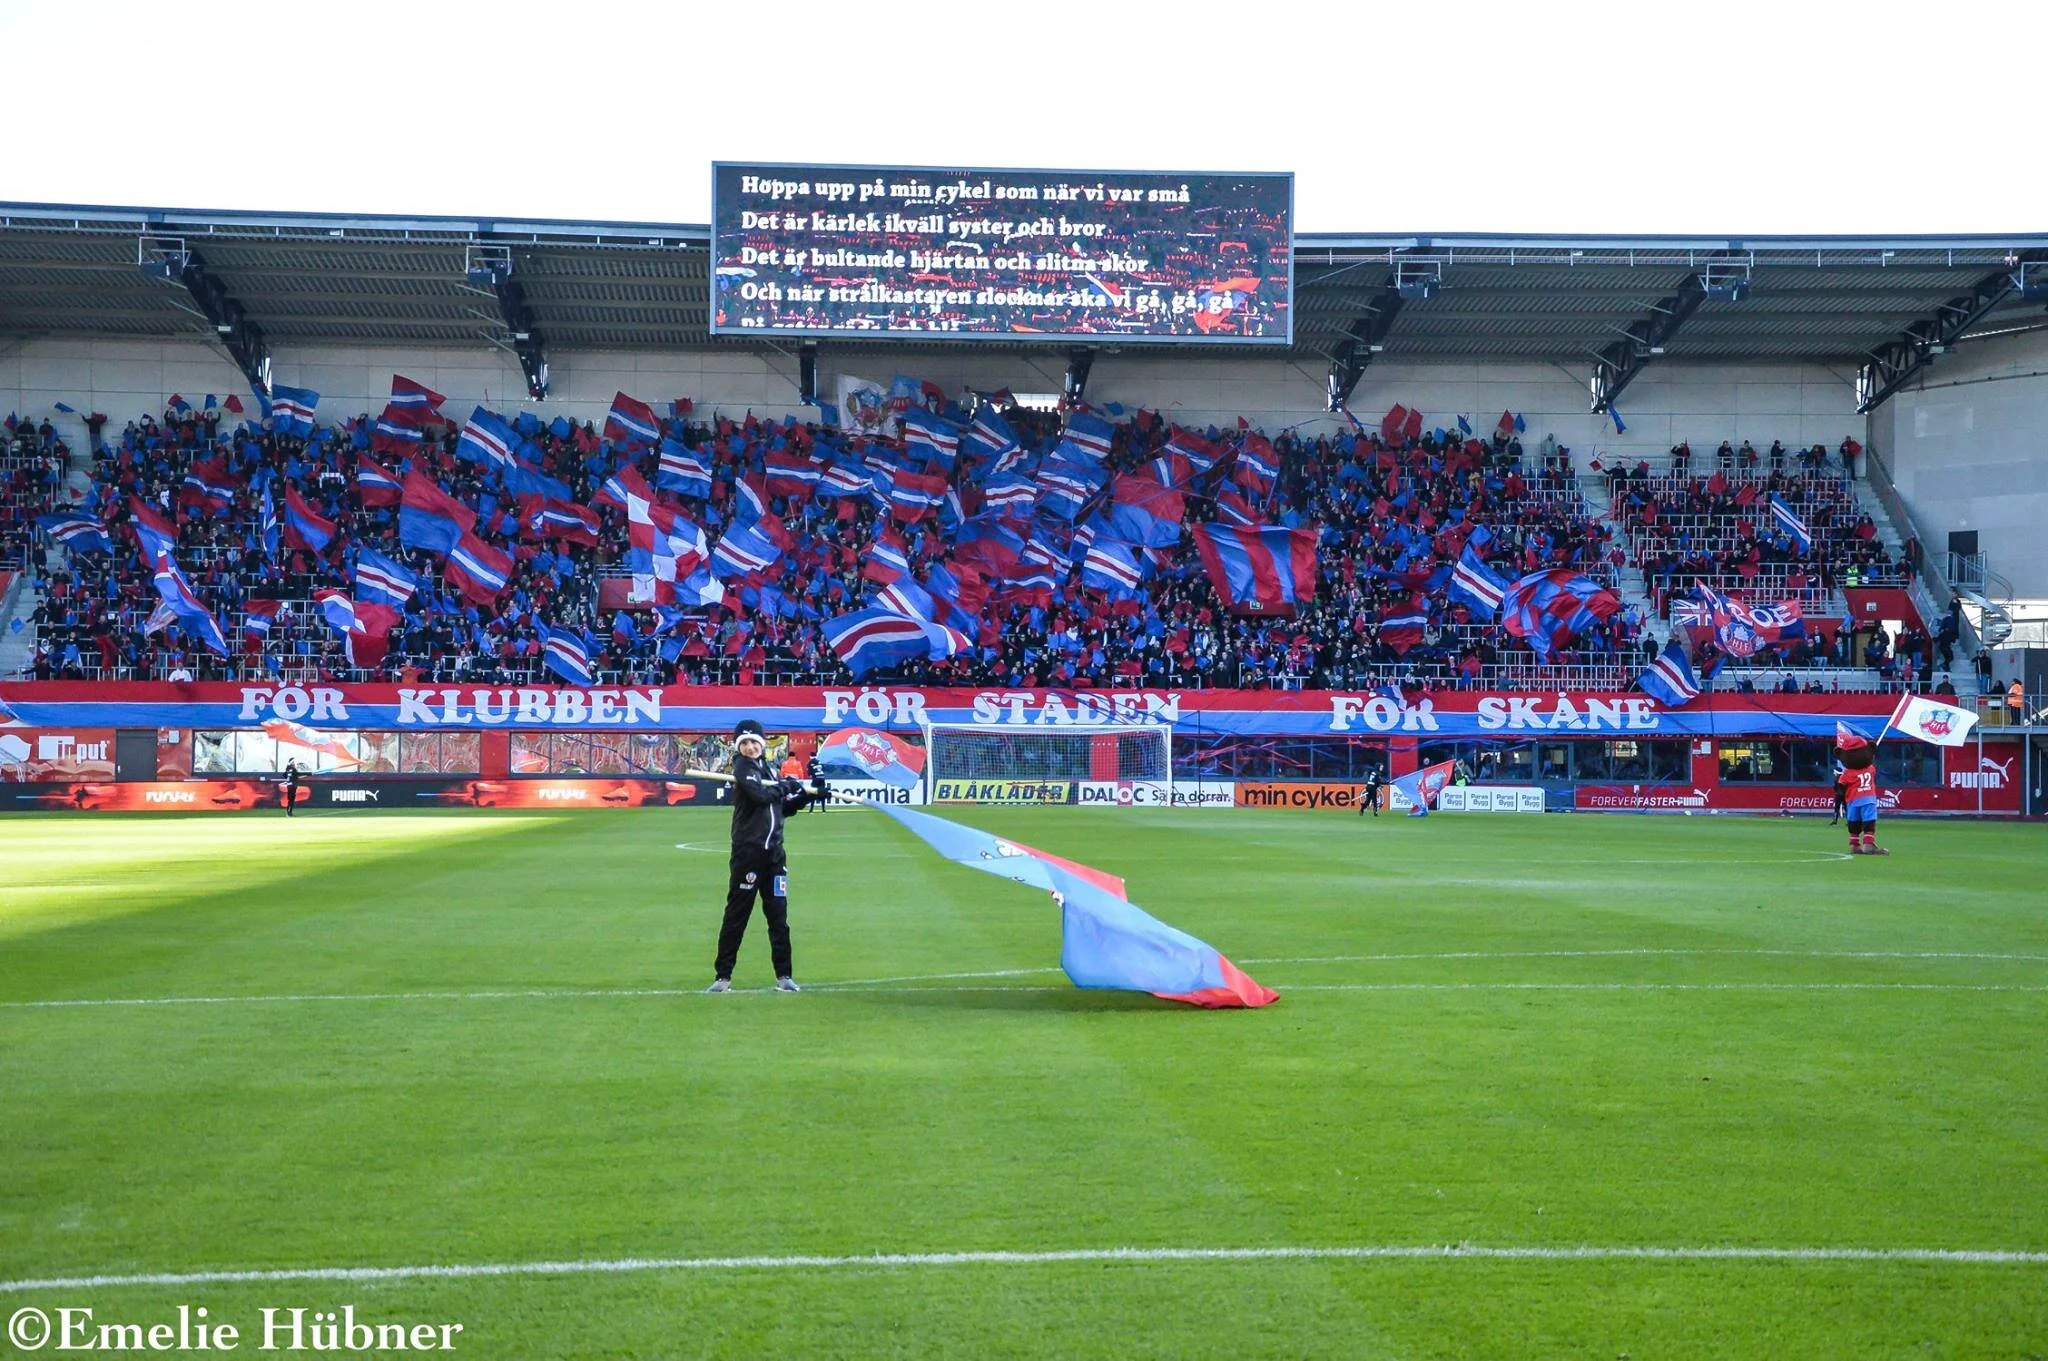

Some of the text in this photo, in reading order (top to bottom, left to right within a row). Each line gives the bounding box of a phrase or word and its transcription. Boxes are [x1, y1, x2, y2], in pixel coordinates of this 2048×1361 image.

[741, 176, 1189, 204] Hoppa upp på min cykel som när vi var små
[741, 211, 1107, 239] Det är kärlek ikväll syster och bror
[741, 247, 1149, 274] Det är bultande hjärtan och slitna skor
[741, 282, 782, 301] Och
[787, 284, 825, 302] när
[829, 283, 971, 305] strålkastaren
[977, 288, 1066, 306] slocknar
[1070, 290, 1106, 307] ska
[1112, 291, 1130, 307] vi
[1209, 290, 1233, 314] gå
[238, 683, 1659, 731] FÖR KLUBBEN FÖR STADEN FÖR SKÅNE
[1857, 772, 1871, 787] 12
[1951, 772, 2000, 788] PUMA
[332, 790, 366, 801] PUMA
[814, 783, 910, 804] hermia
[938, 781, 1063, 800] BLÅKLÄDER
[1083, 787, 1144, 802] DALOC
[1152, 790, 1185, 802] Sära
[1245, 785, 1355, 808] min cykel
